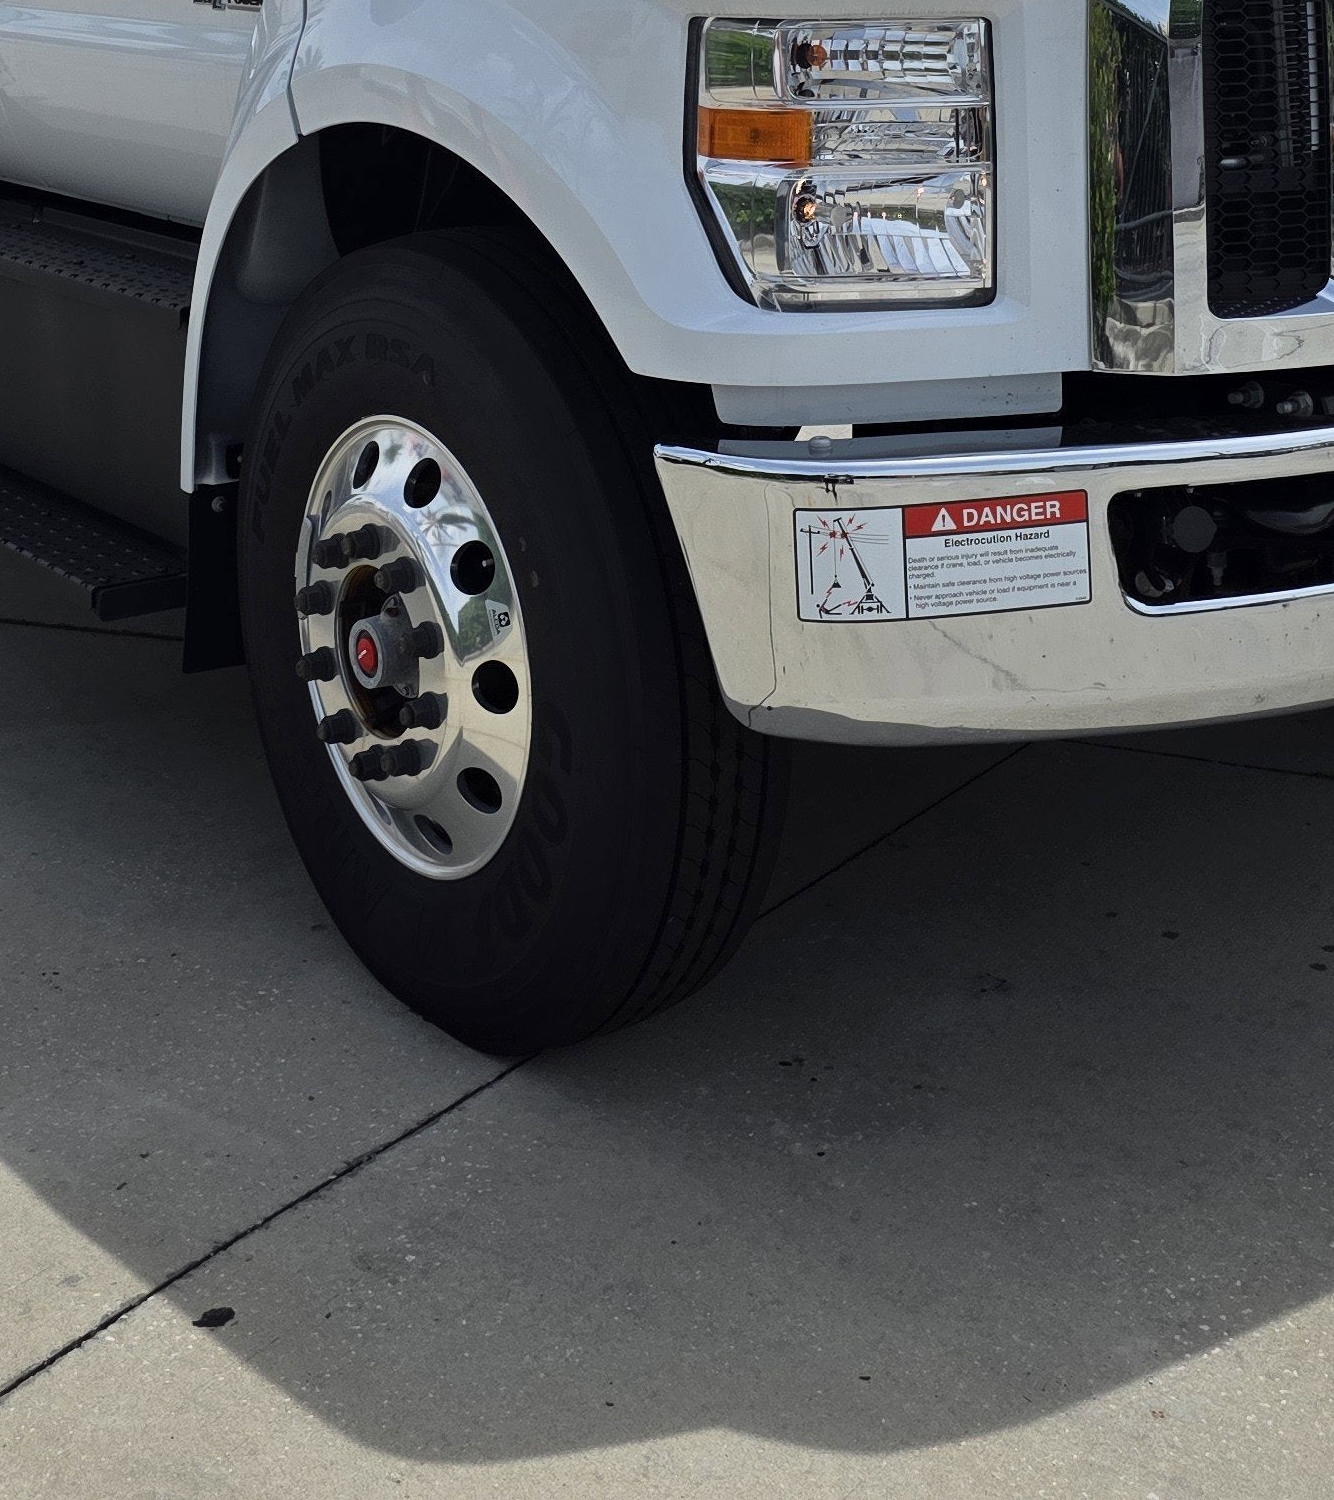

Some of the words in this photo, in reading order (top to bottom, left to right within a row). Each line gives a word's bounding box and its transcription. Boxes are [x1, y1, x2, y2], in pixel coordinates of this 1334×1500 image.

[291, 333, 357, 408] MAX
[962, 500, 1061, 527] DANGER
[944, 533, 1012, 548] Electrocution
[1015, 530, 1050, 542] Hazard
